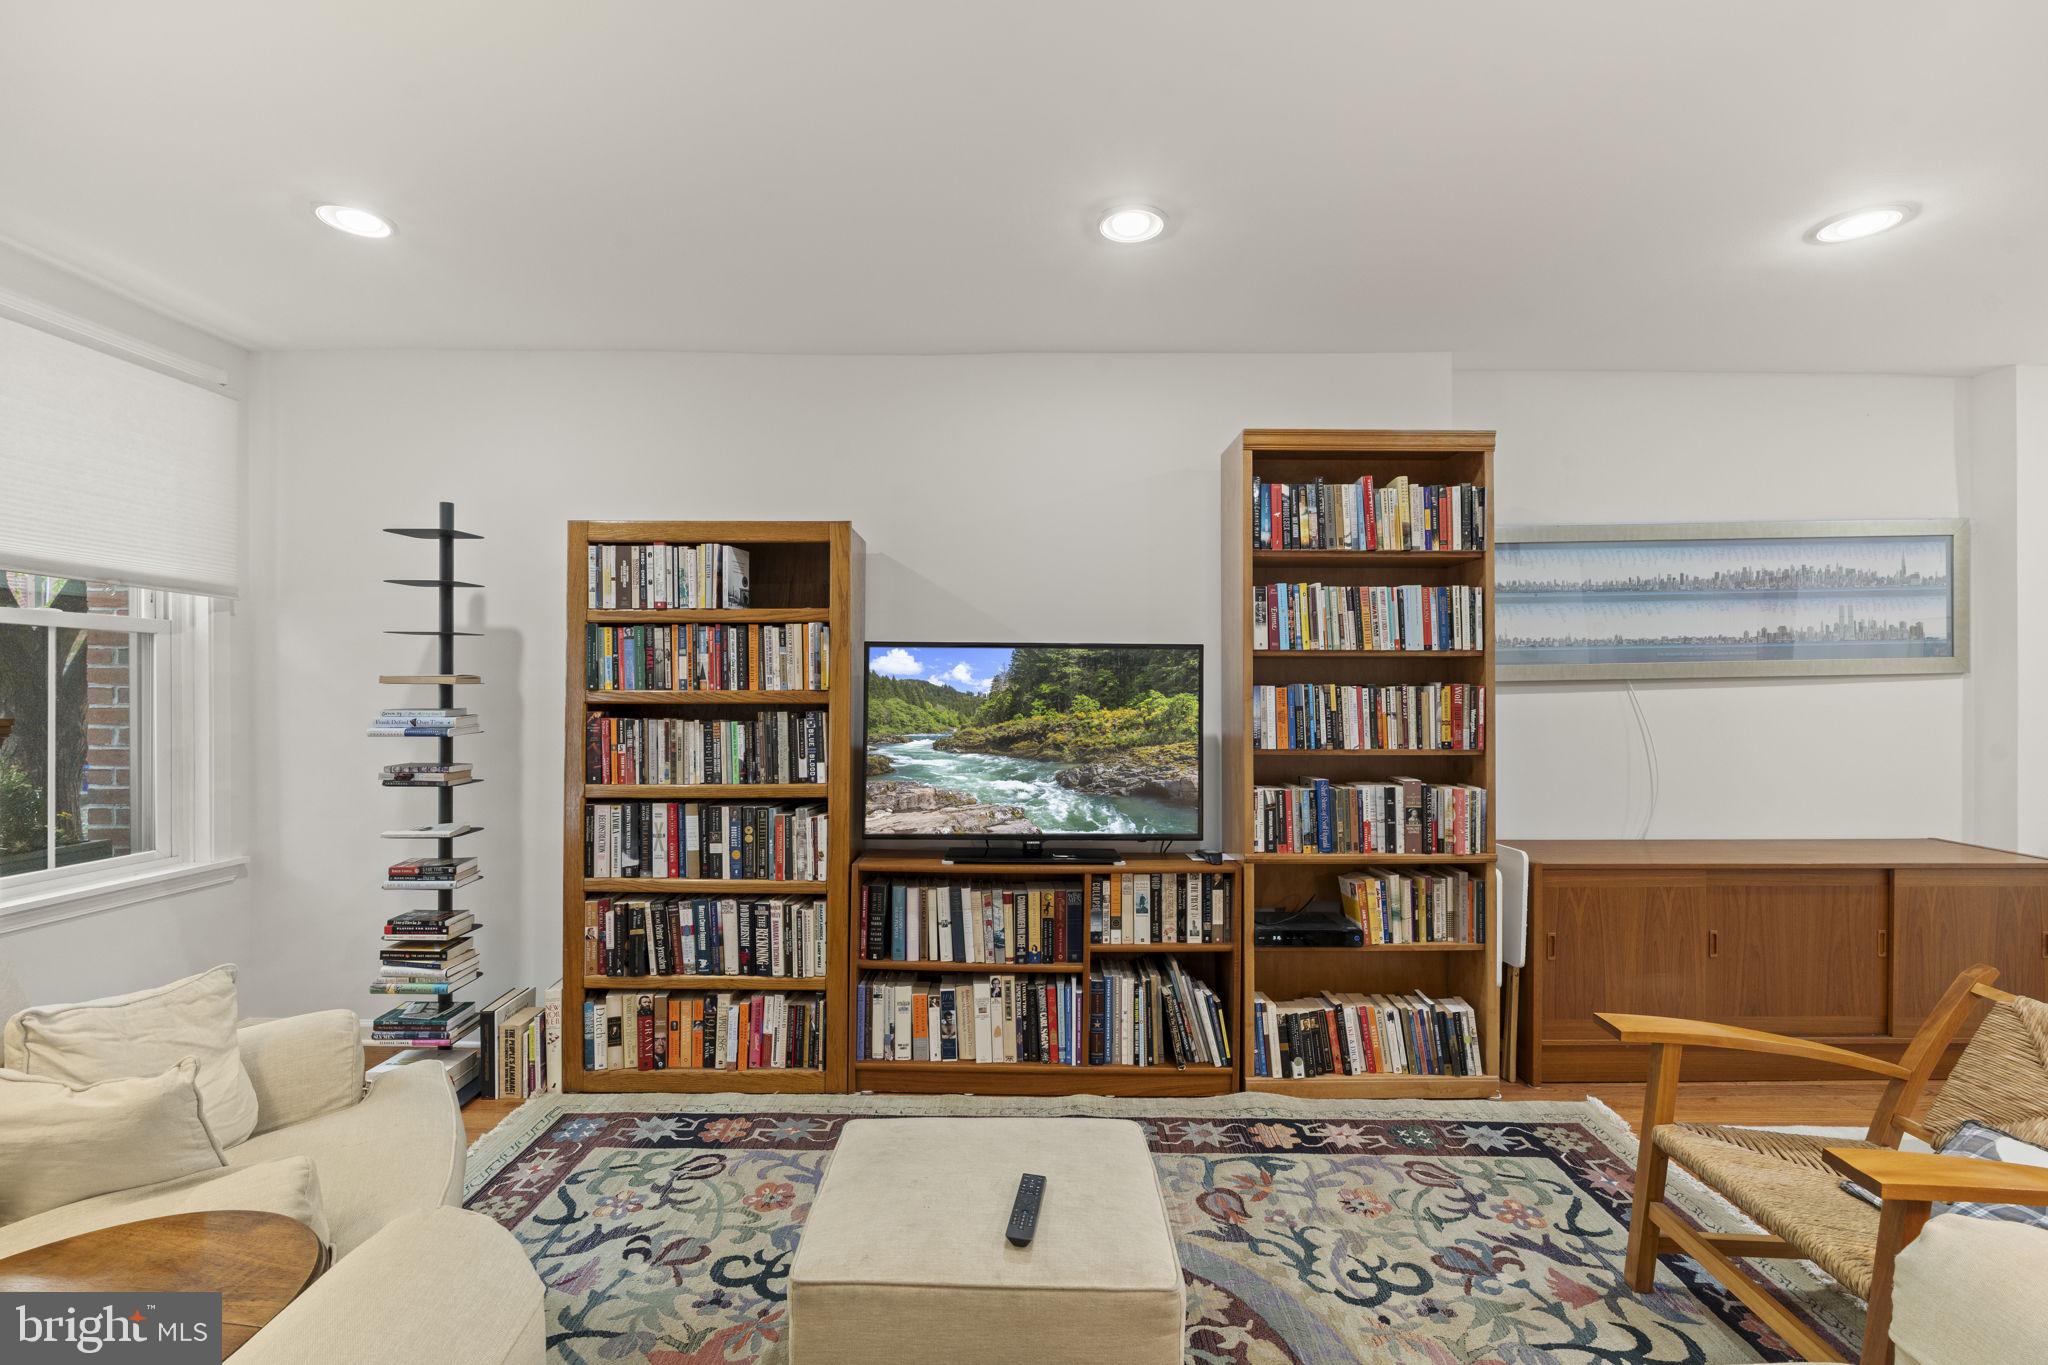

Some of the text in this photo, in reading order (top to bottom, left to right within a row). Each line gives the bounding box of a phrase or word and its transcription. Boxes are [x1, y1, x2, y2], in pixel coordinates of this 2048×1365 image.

[1454, 686, 1462, 704] Wolf
[1092, 882, 1101, 912] COLLAPSE
[1190, 883, 1198, 894] THE
[755, 916, 769, 965] THE RECKONING
[595, 1008, 605, 1039] Dutch
[645, 1019, 653, 1057] GRANT
[1040, 1026, 1048, 1048] SAGAN
